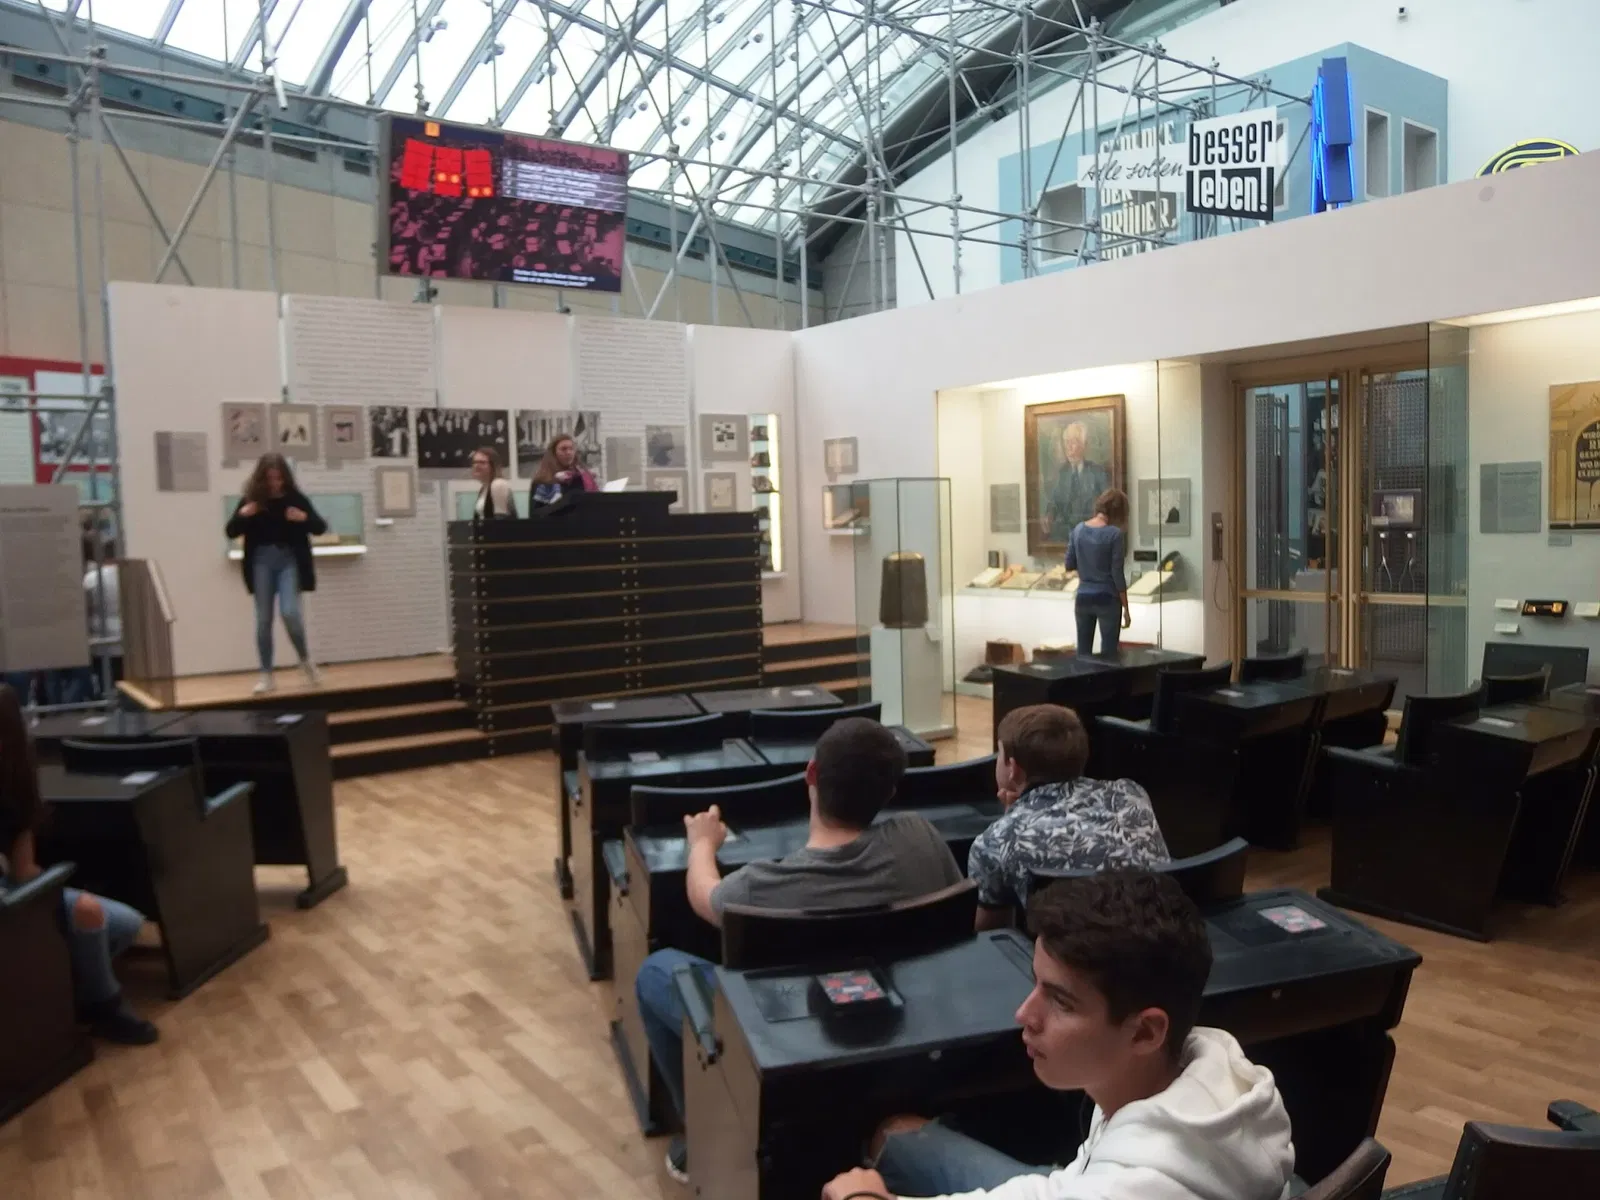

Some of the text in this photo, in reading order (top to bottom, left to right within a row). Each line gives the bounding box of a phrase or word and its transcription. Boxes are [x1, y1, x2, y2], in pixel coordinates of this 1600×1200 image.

[1189, 120, 1273, 166] besser
[1081, 156, 1184, 181] Alle sollen
[1192, 167, 1268, 213] leben!
